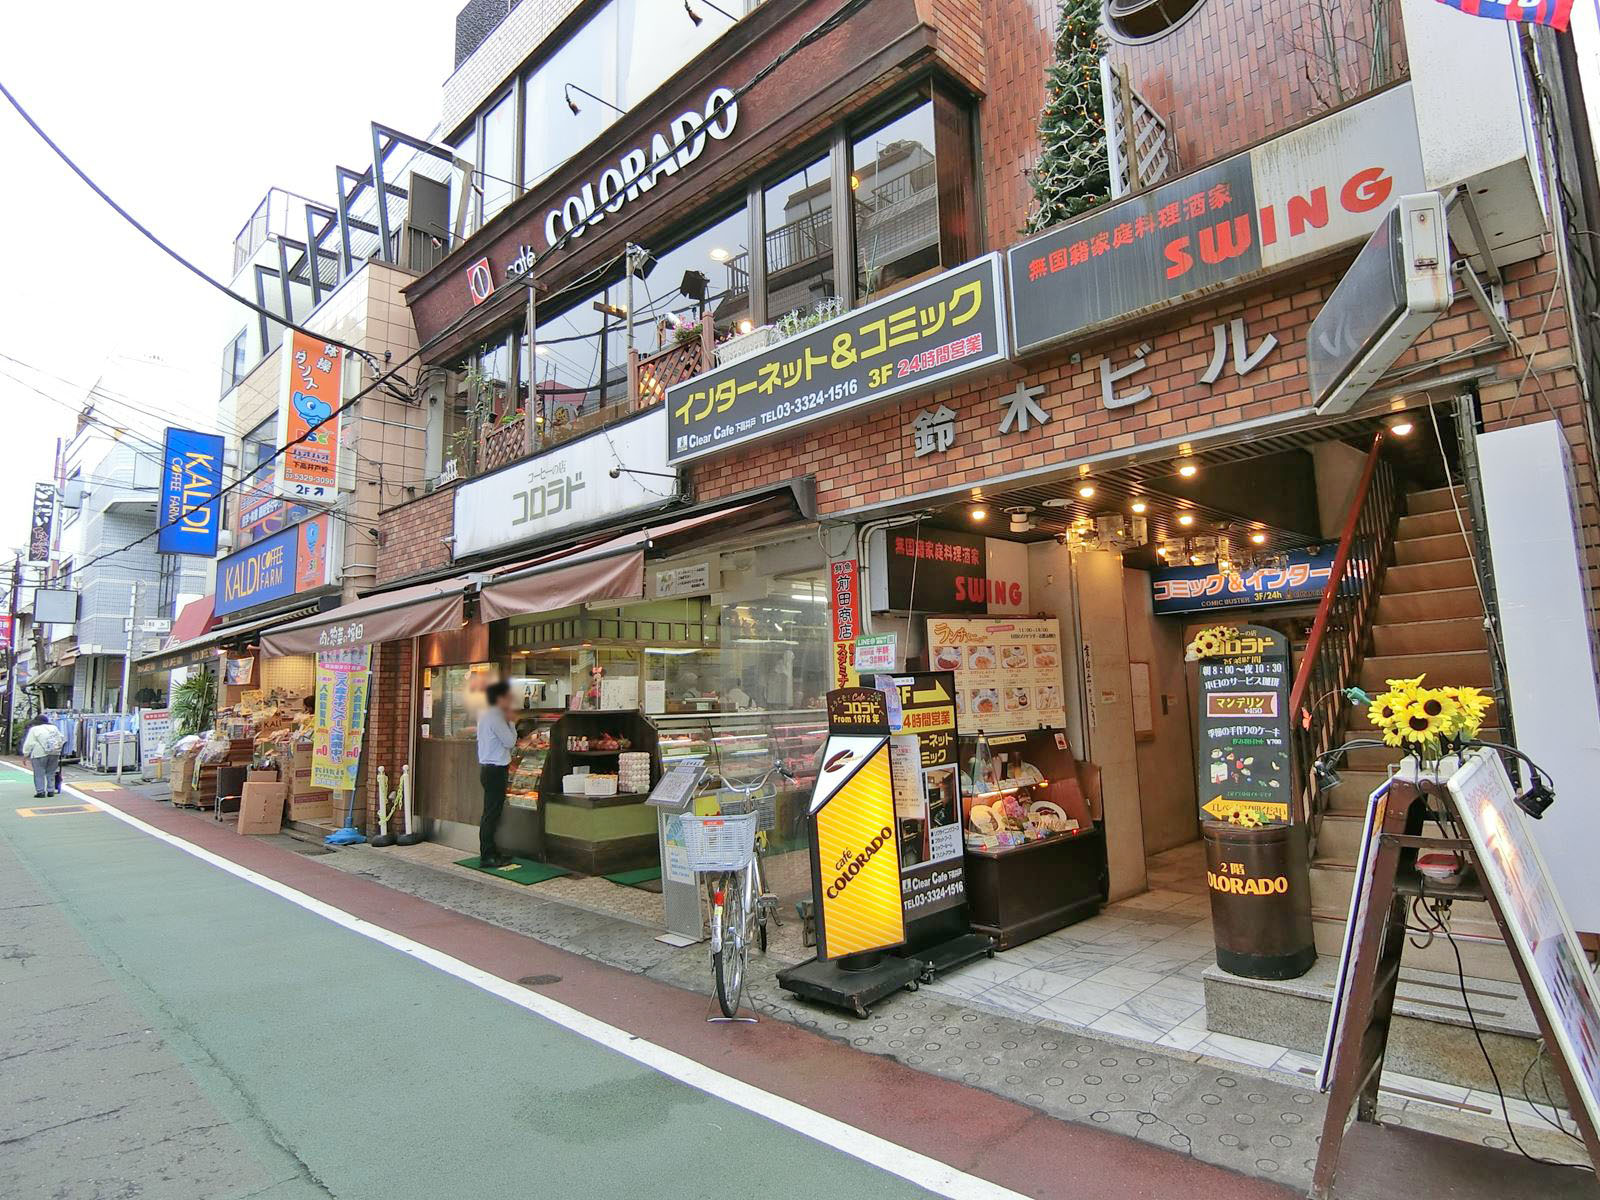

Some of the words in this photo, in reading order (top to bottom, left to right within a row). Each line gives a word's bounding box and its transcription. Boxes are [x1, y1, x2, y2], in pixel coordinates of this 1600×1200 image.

[544, 87, 740, 250] COLORADO
[1028, 182, 1234, 283] 無国籍家庭料理酒家
[1163, 167, 1393, 281] SWING
[868, 364, 893, 390] 3F
[897, 332, 983, 379] 24時間営業
[911, 317, 1278, 459] 鈴木ビル
[689, 433, 712, 449] Clear
[713, 424, 735, 441] Cafe
[169, 457, 183, 492] COFFEE
[528, 460, 567, 484] コーヒーの店
[181, 451, 214, 534] KALDI
[296, 484, 310, 495] 2F
[512, 471, 586, 526] コロラド
[224, 554, 260, 602] KALDI
[261, 545, 284, 571] COFFEE
[260, 566, 283, 590] FARM
[1153, 562, 1335, 601] コミック&インター
[955, 576, 1022, 606] SWING
[1254, 591, 1283, 601] 3F/24h
[837, 574, 853, 640] 前田商店
[1239, 629, 1257, 637] ーの店
[836, 643, 849, 689] スタミナ
[843, 701, 880, 715] コロラド
[1216, 697, 1265, 708] マンデリン
[833, 714, 852, 723] From
[853, 714, 870, 723] 1978
[903, 710, 951, 728] 4時間営業
[919, 732, 953, 748] ーネット
[921, 749, 947, 764] ミック
[826, 826, 893, 899] COLORADO
[835, 847, 853, 871] café
[912, 877, 931, 889] Clear
[932, 872, 948, 884] Cafe
[1207, 871, 1289, 896] OLORADO
